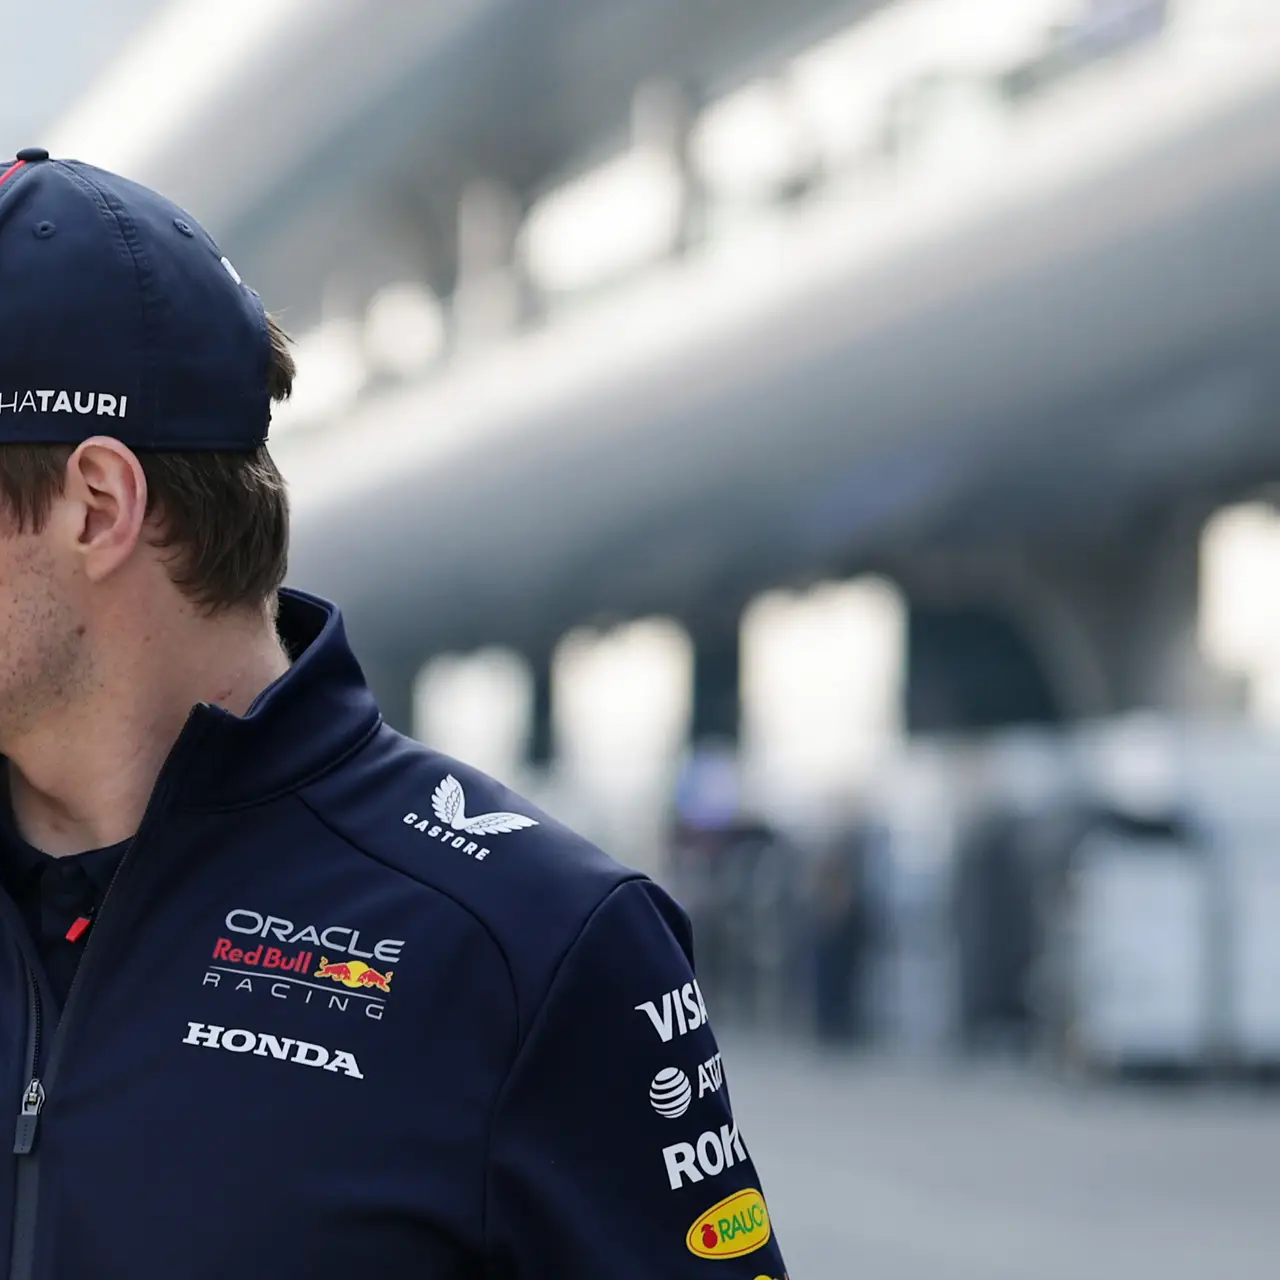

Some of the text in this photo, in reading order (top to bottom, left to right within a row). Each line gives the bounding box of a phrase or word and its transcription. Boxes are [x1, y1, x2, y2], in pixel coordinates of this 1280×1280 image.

[403, 811, 491, 861] CASTORE
[211, 938, 313, 974] Red Bull
[225, 908, 406, 963] ORACLE
[202, 972, 385, 1020] RACING
[182, 1022, 364, 1079] HONDA
[718, 1203, 765, 1243] RAUC
